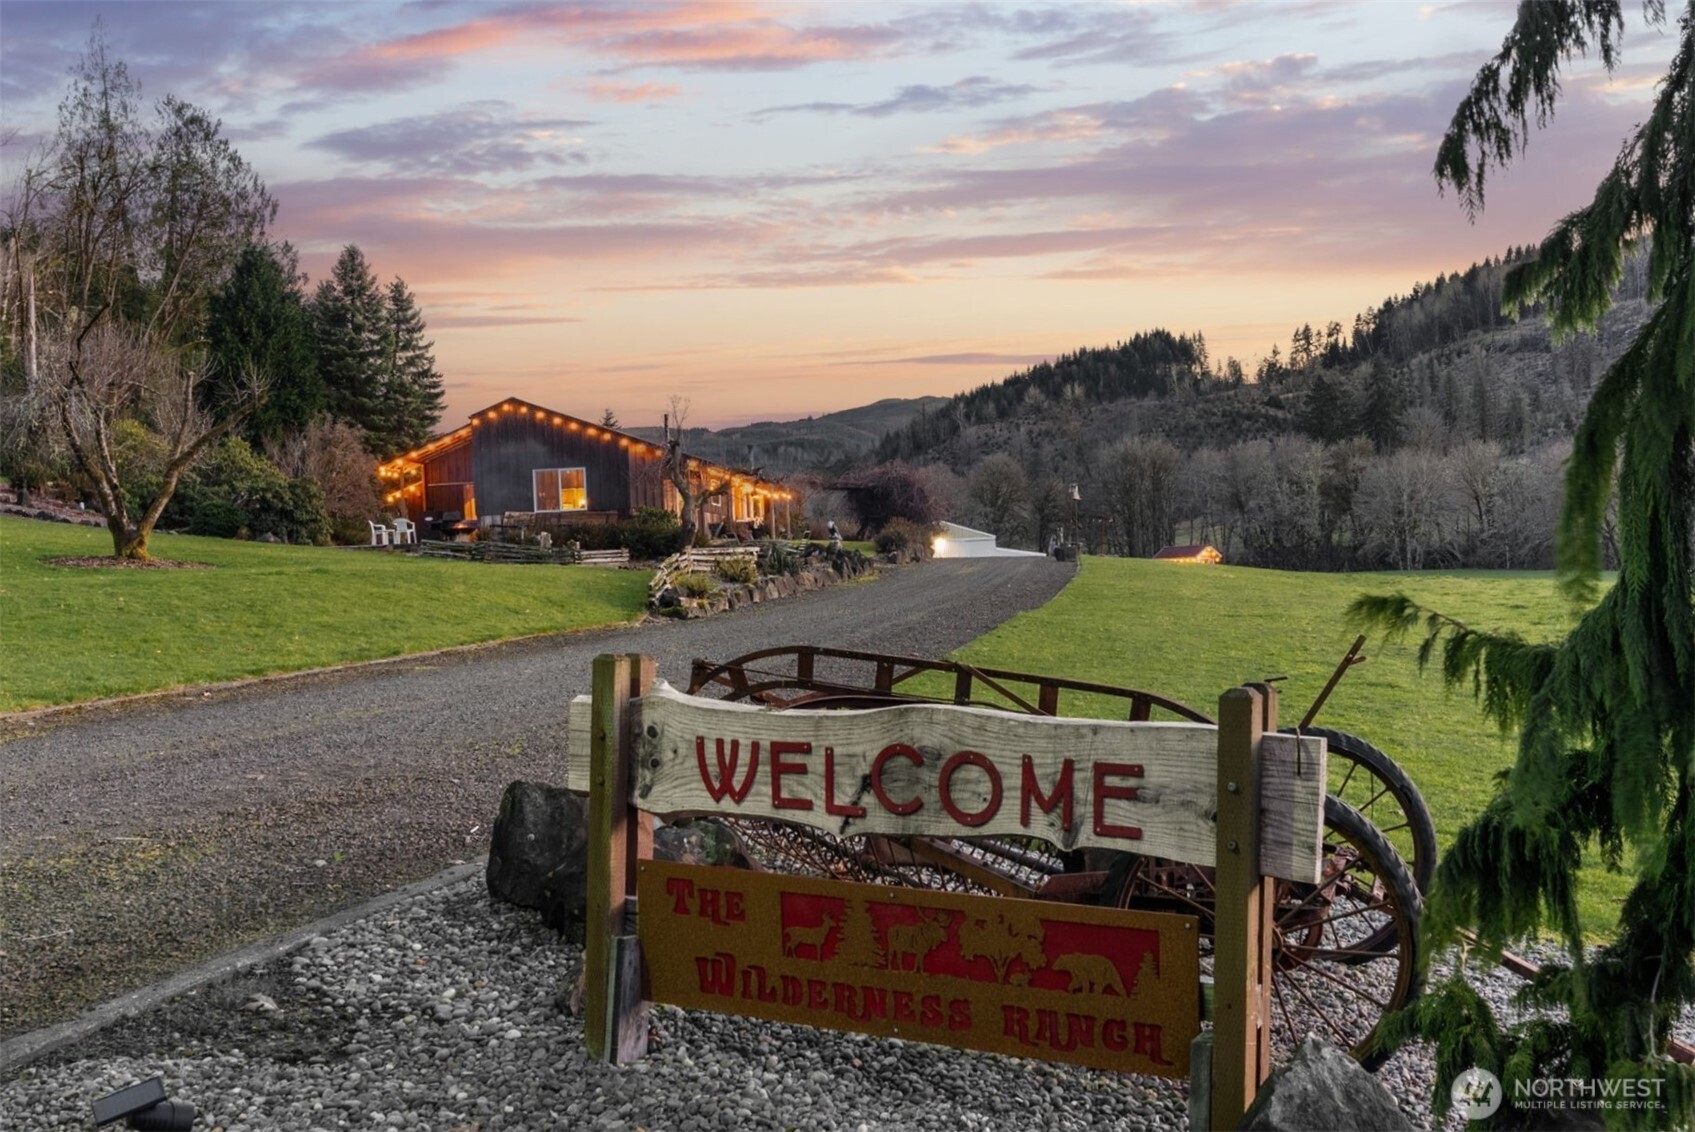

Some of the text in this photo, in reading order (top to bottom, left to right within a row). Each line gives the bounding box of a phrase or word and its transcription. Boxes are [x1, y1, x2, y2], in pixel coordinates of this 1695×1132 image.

[696, 736, 1144, 839] WELCOME
[666, 878, 746, 924] THE
[696, 952, 1173, 1066] WILDERNESS RANCH
